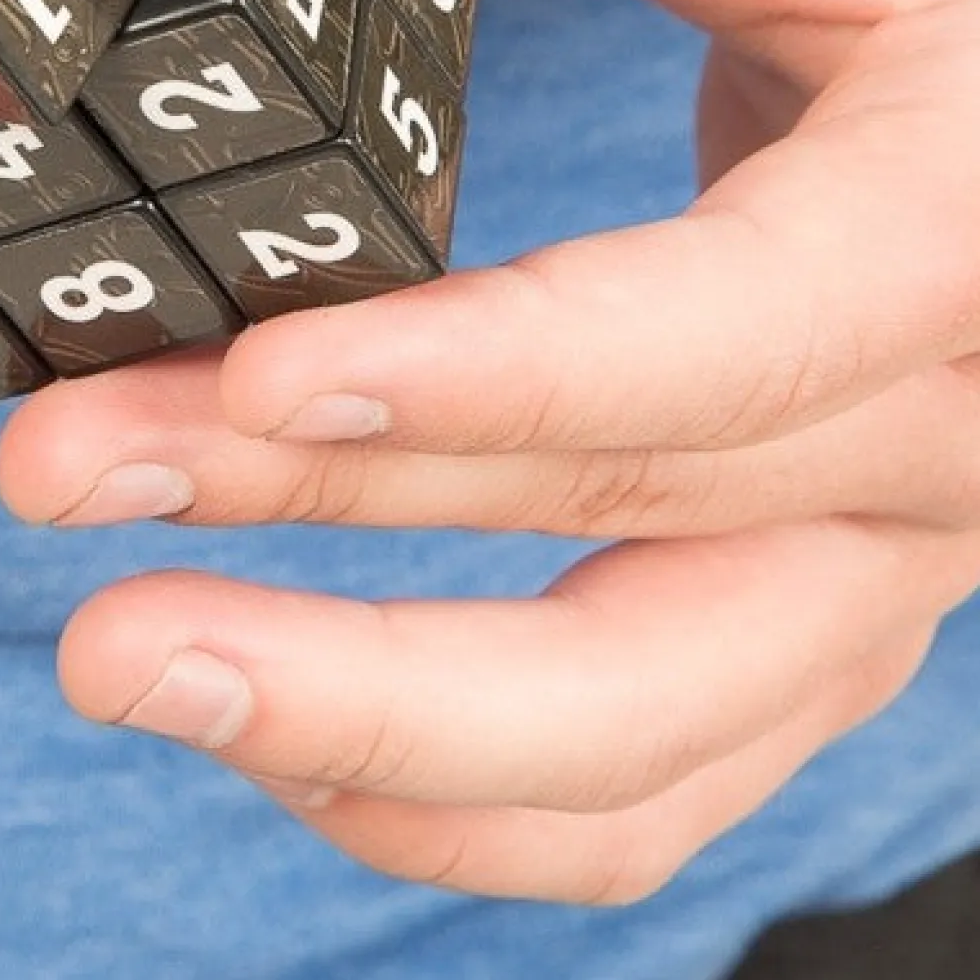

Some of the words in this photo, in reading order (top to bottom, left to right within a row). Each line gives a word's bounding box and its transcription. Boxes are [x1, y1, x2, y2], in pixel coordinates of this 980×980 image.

[138, 61, 265, 130] 2
[380, 66, 439, 177] 5
[238, 213, 360, 280] 2
[40, 259, 156, 323] 8
